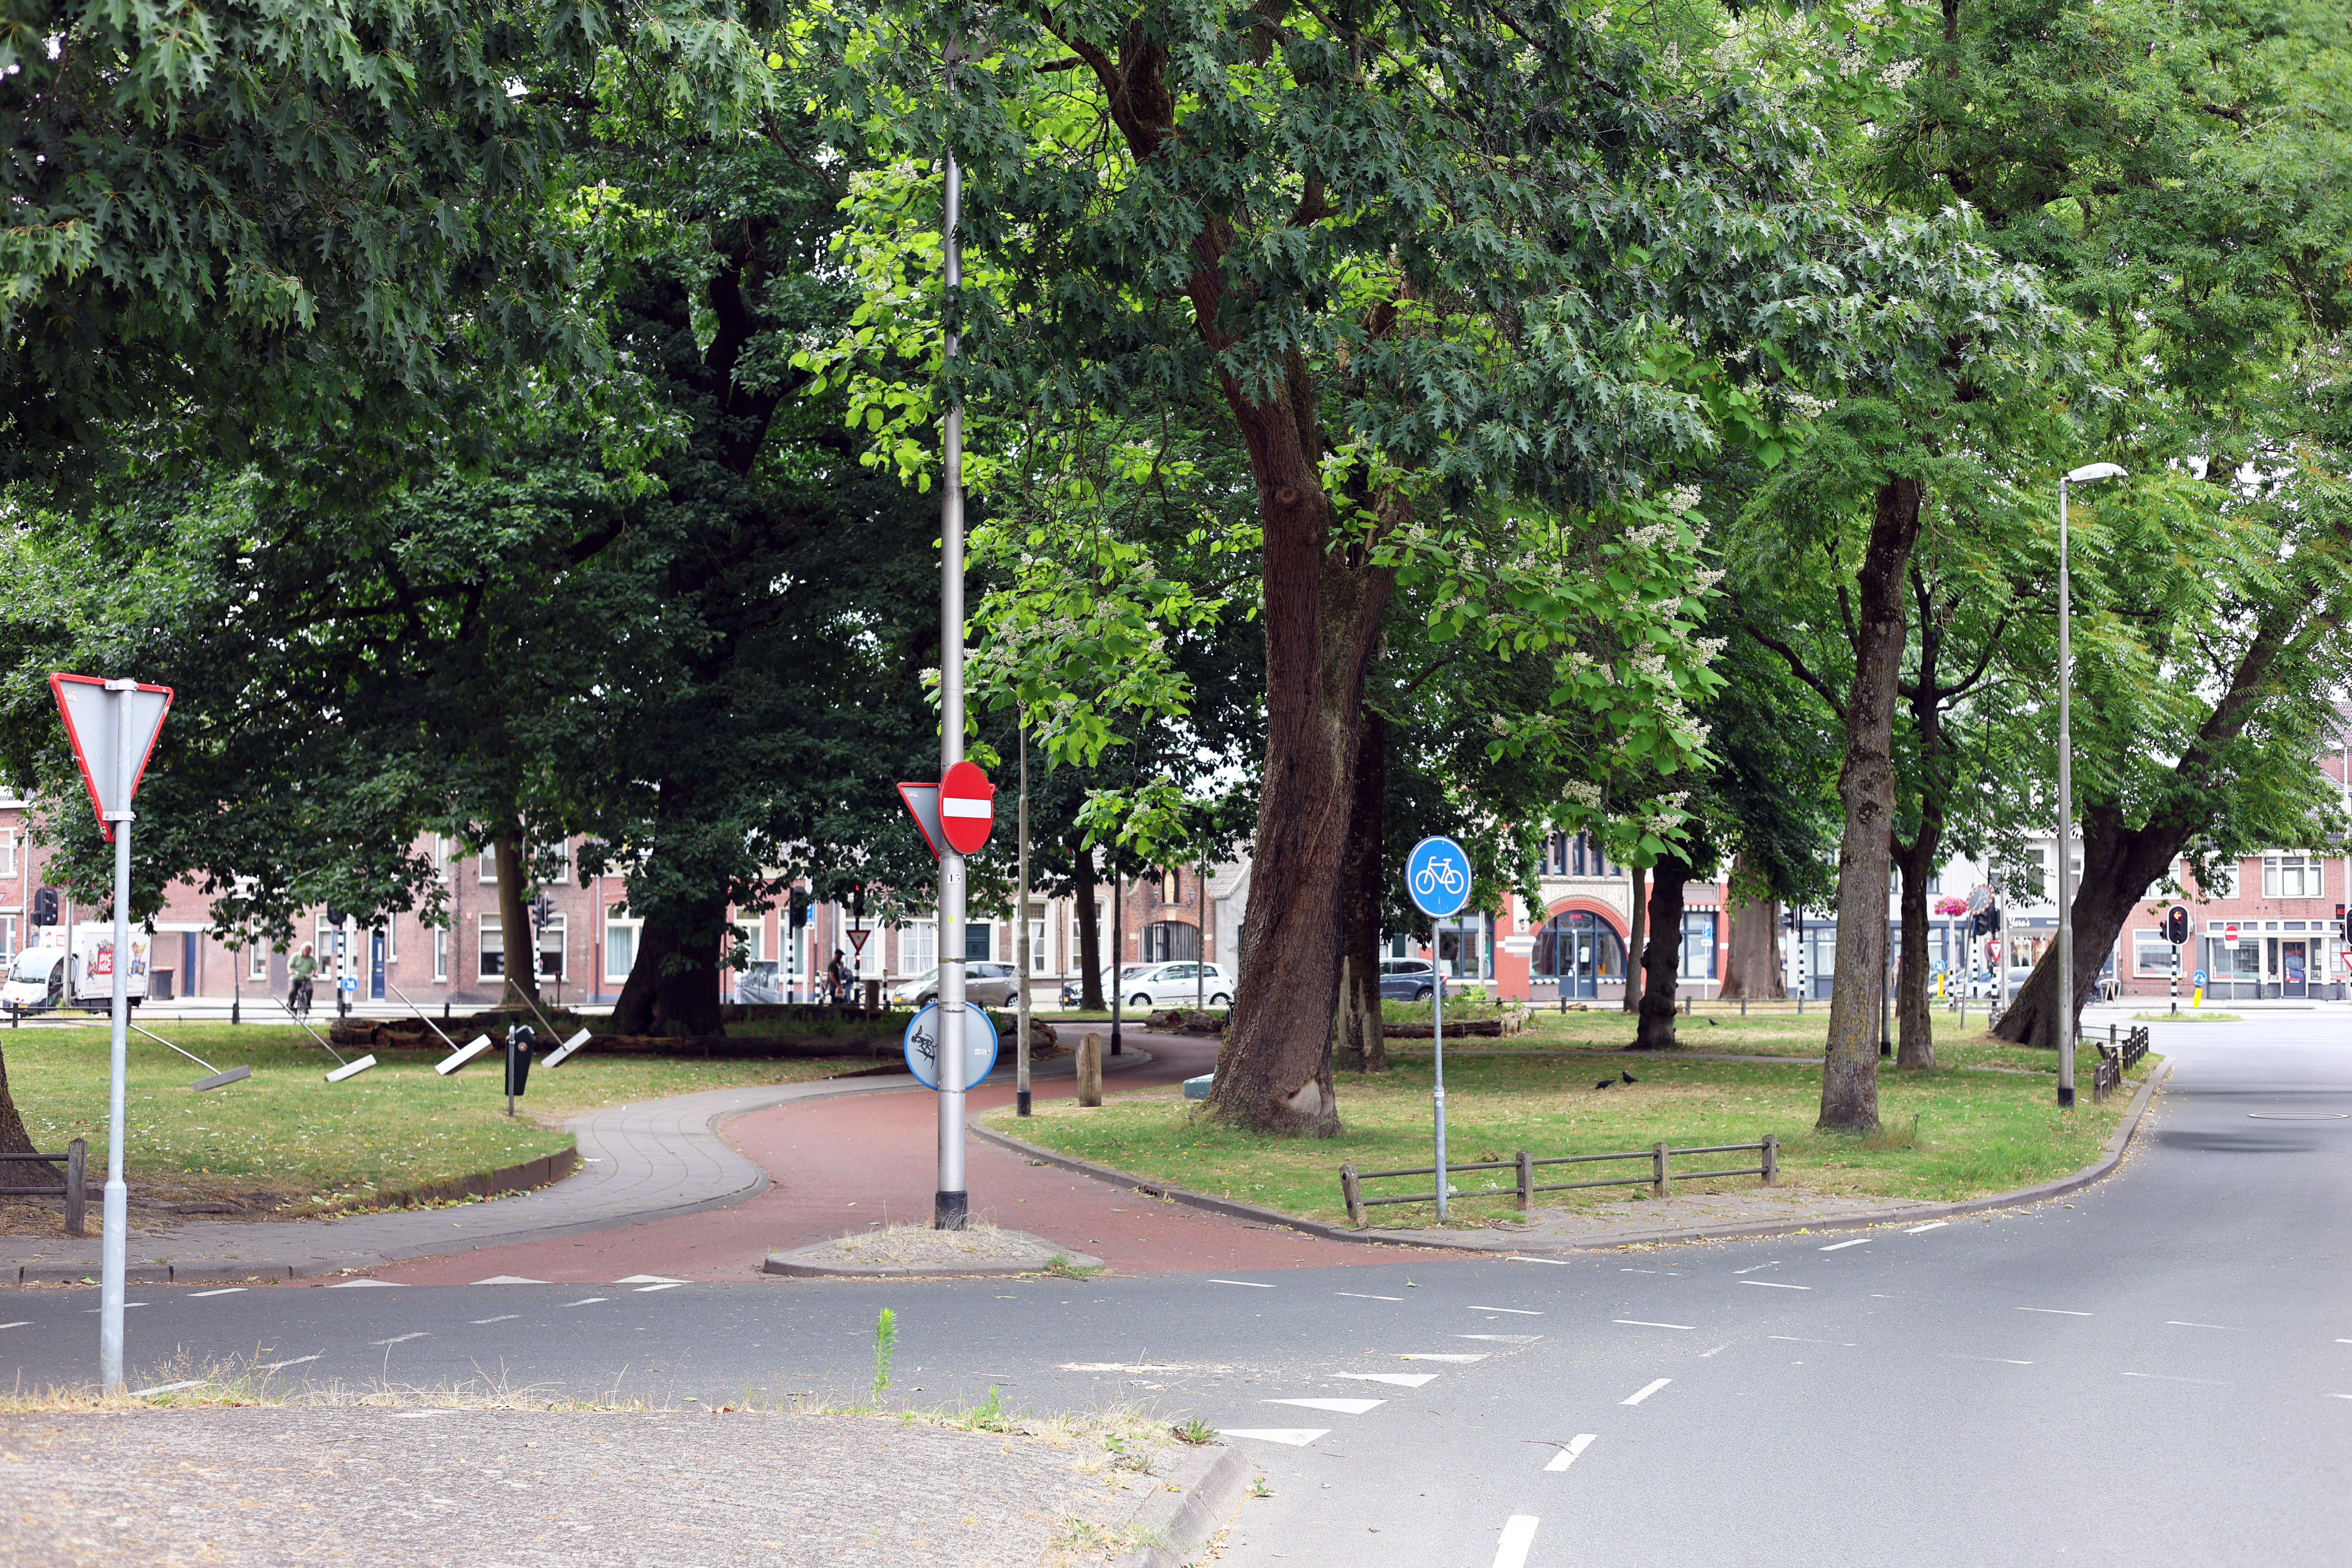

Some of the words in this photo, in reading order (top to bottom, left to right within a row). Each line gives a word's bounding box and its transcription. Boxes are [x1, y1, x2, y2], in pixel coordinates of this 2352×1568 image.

[948, 874, 960, 882] 15
[1581, 886, 1616, 904] MONTAGNES
[2008, 917, 2030, 929] Yara's
[100, 953, 111, 962] PIC
[99, 963, 111, 972] NIC
